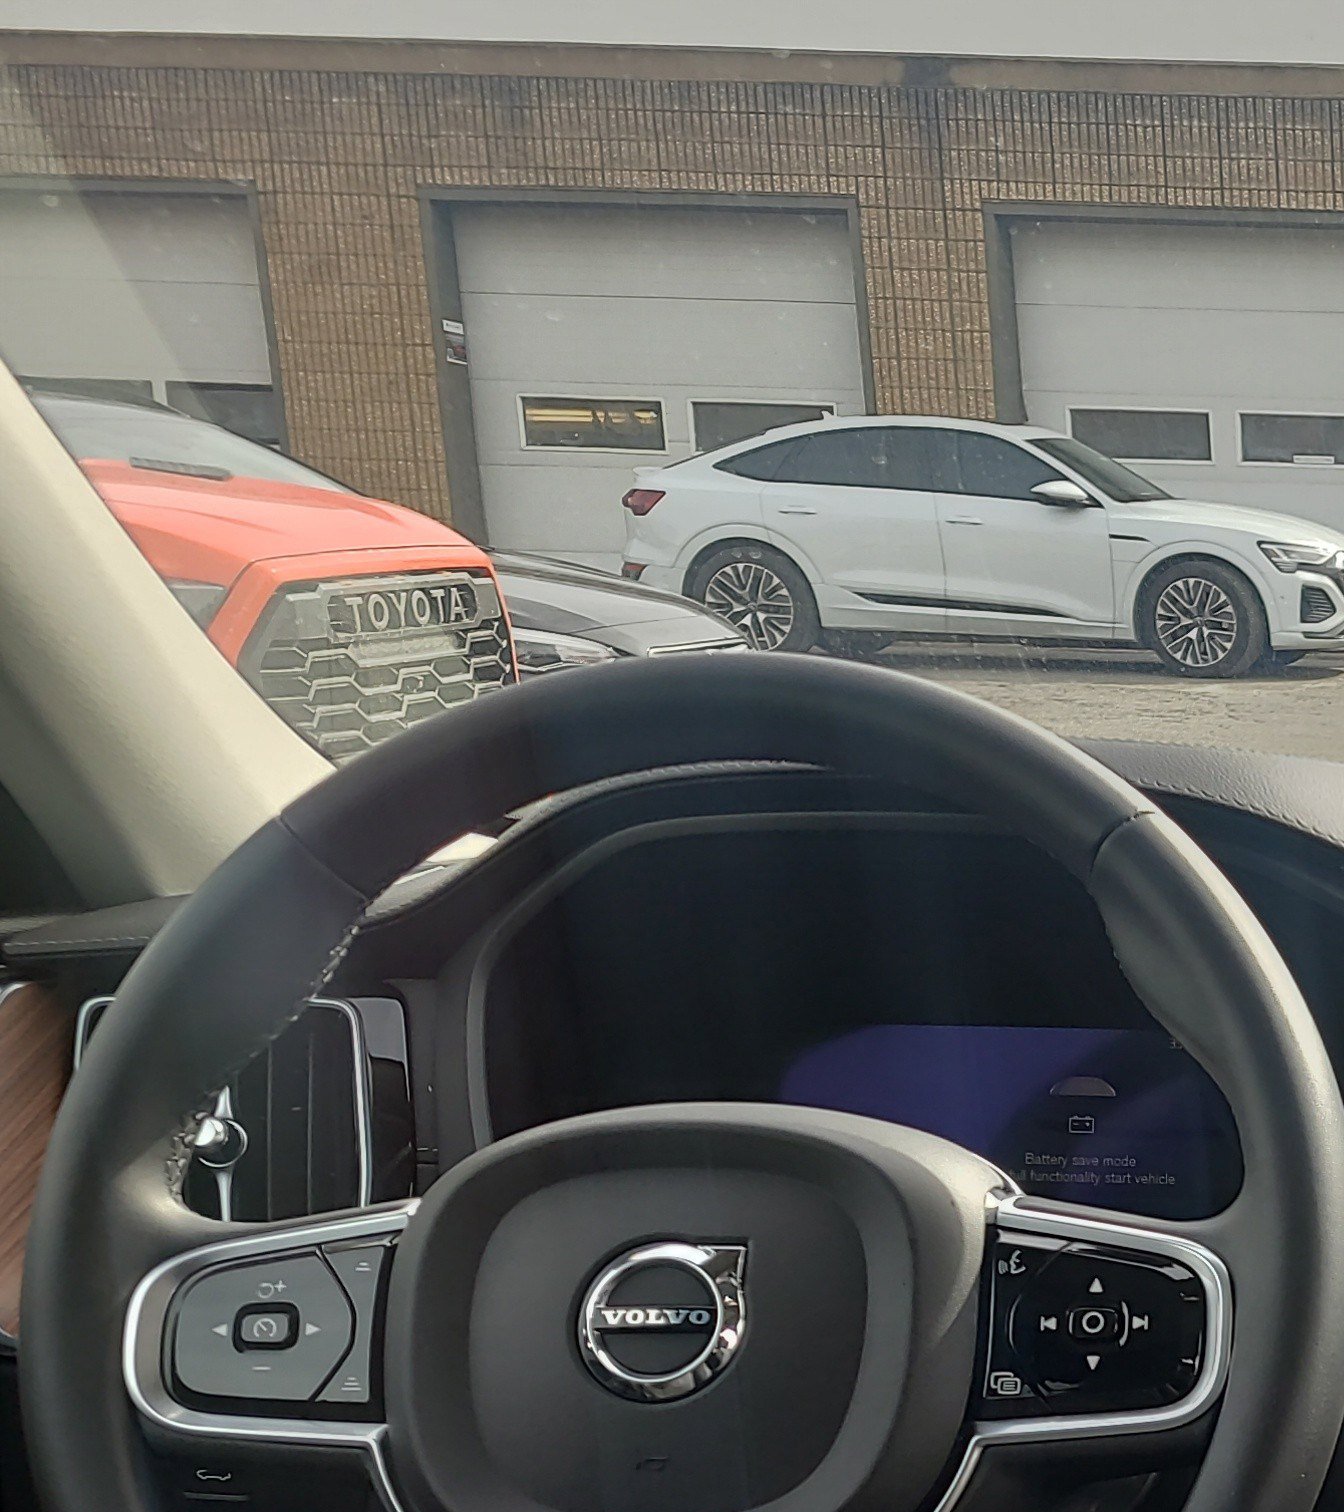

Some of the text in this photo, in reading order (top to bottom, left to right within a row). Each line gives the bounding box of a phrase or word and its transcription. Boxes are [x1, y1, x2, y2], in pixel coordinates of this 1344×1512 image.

[344, 587, 470, 634] TOYOTA
[1025, 1153, 1137, 1167] Battery save mode
[1030, 1169, 1100, 1186] functionality
[1105, 1173, 1132, 1184] start
[1135, 1173, 1176, 1185] vehicle
[601, 1309, 711, 1325] VOLVO
